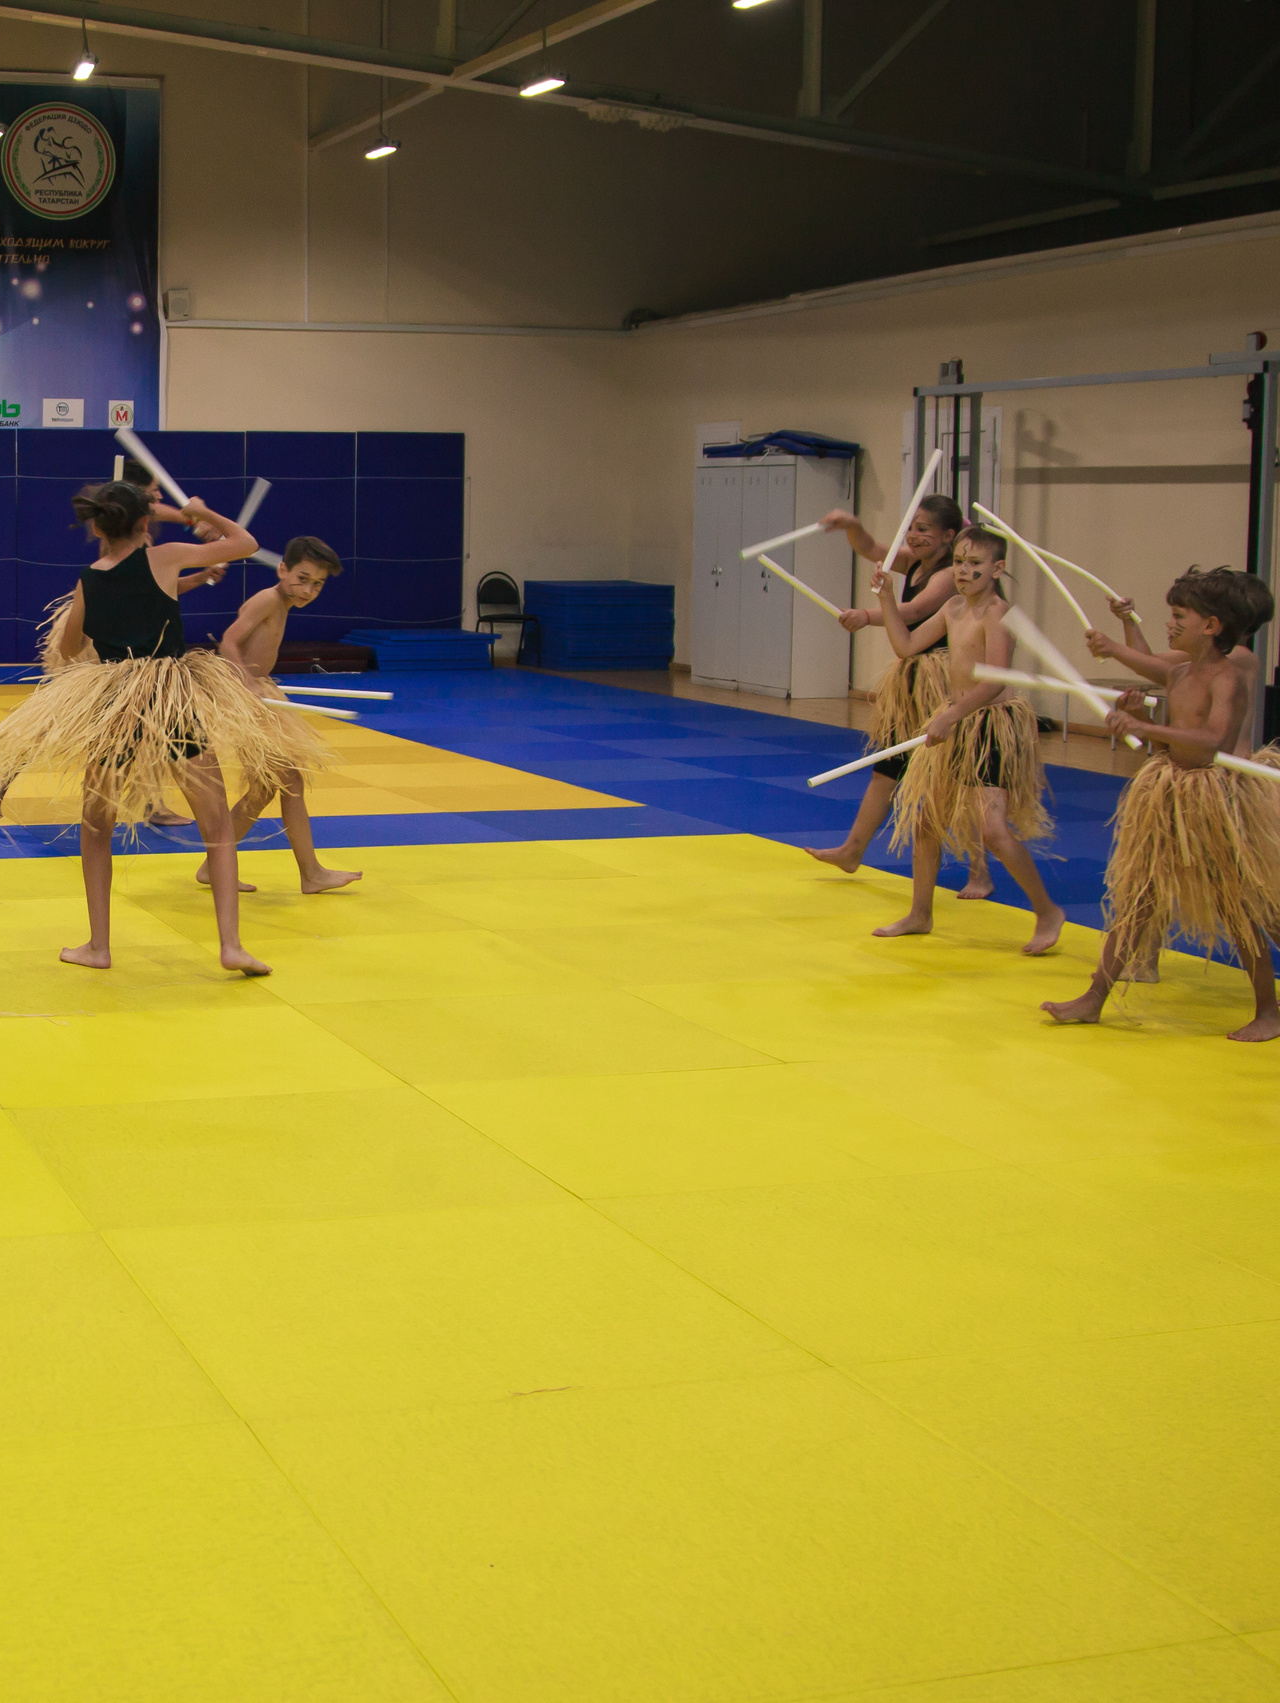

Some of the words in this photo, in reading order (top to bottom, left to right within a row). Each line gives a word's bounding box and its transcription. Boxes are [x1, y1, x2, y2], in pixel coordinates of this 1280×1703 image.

[25, 113, 67, 131] ФЕДЕРАЦИЯ
[67, 116, 92, 134] ДЗЮДО
[34, 189, 83, 197] РЕСПУБЛИКА
[38, 197, 80, 205] ТАТАРСТАН
